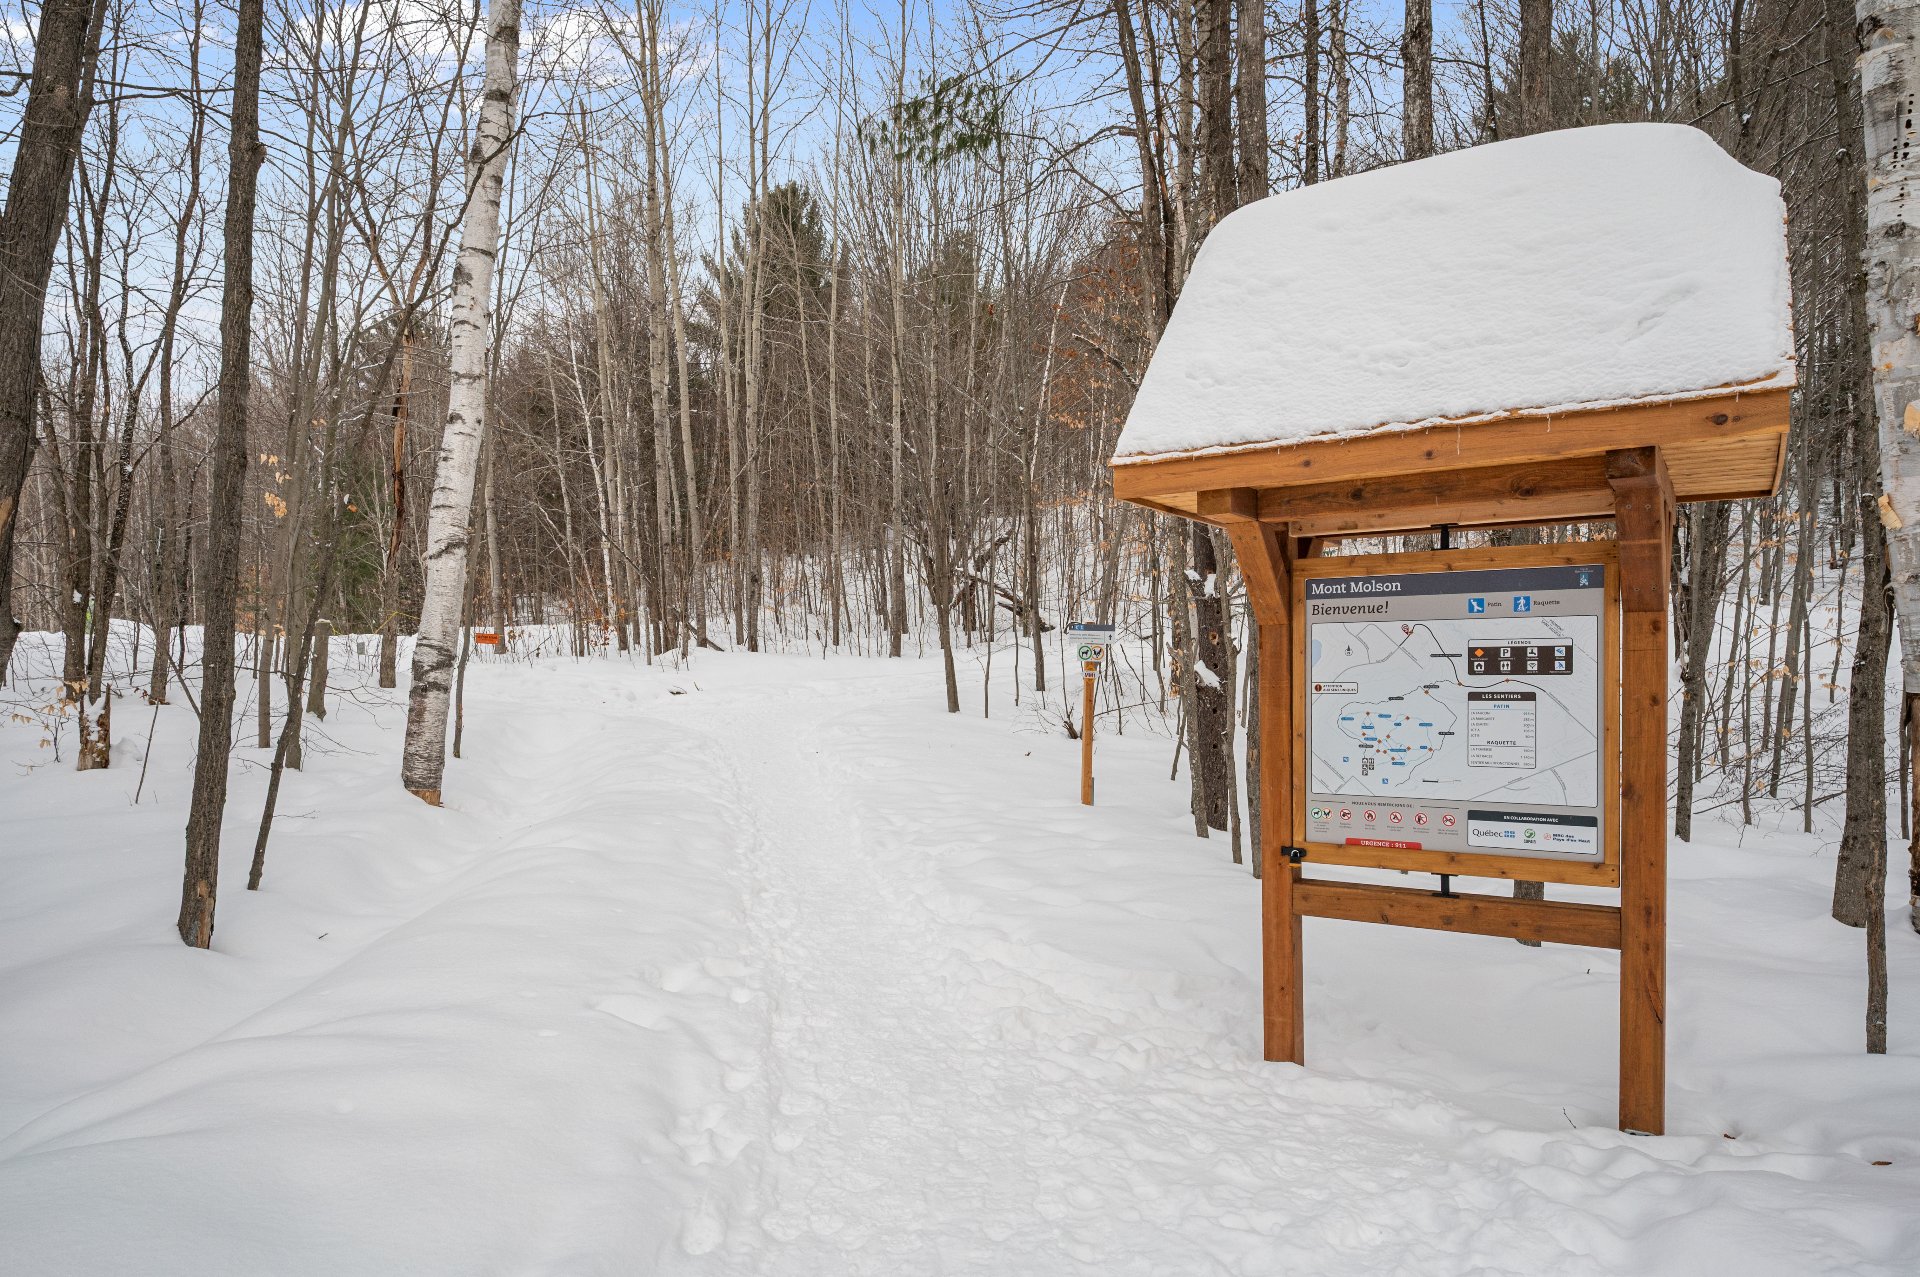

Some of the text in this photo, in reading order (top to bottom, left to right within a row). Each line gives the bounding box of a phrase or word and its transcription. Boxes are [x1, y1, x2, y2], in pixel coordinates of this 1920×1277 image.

[1311, 580, 1402, 595] Mont Molson
[1311, 601, 1389, 616] Bienvenue!
[1472, 828, 1503, 838] Québec
